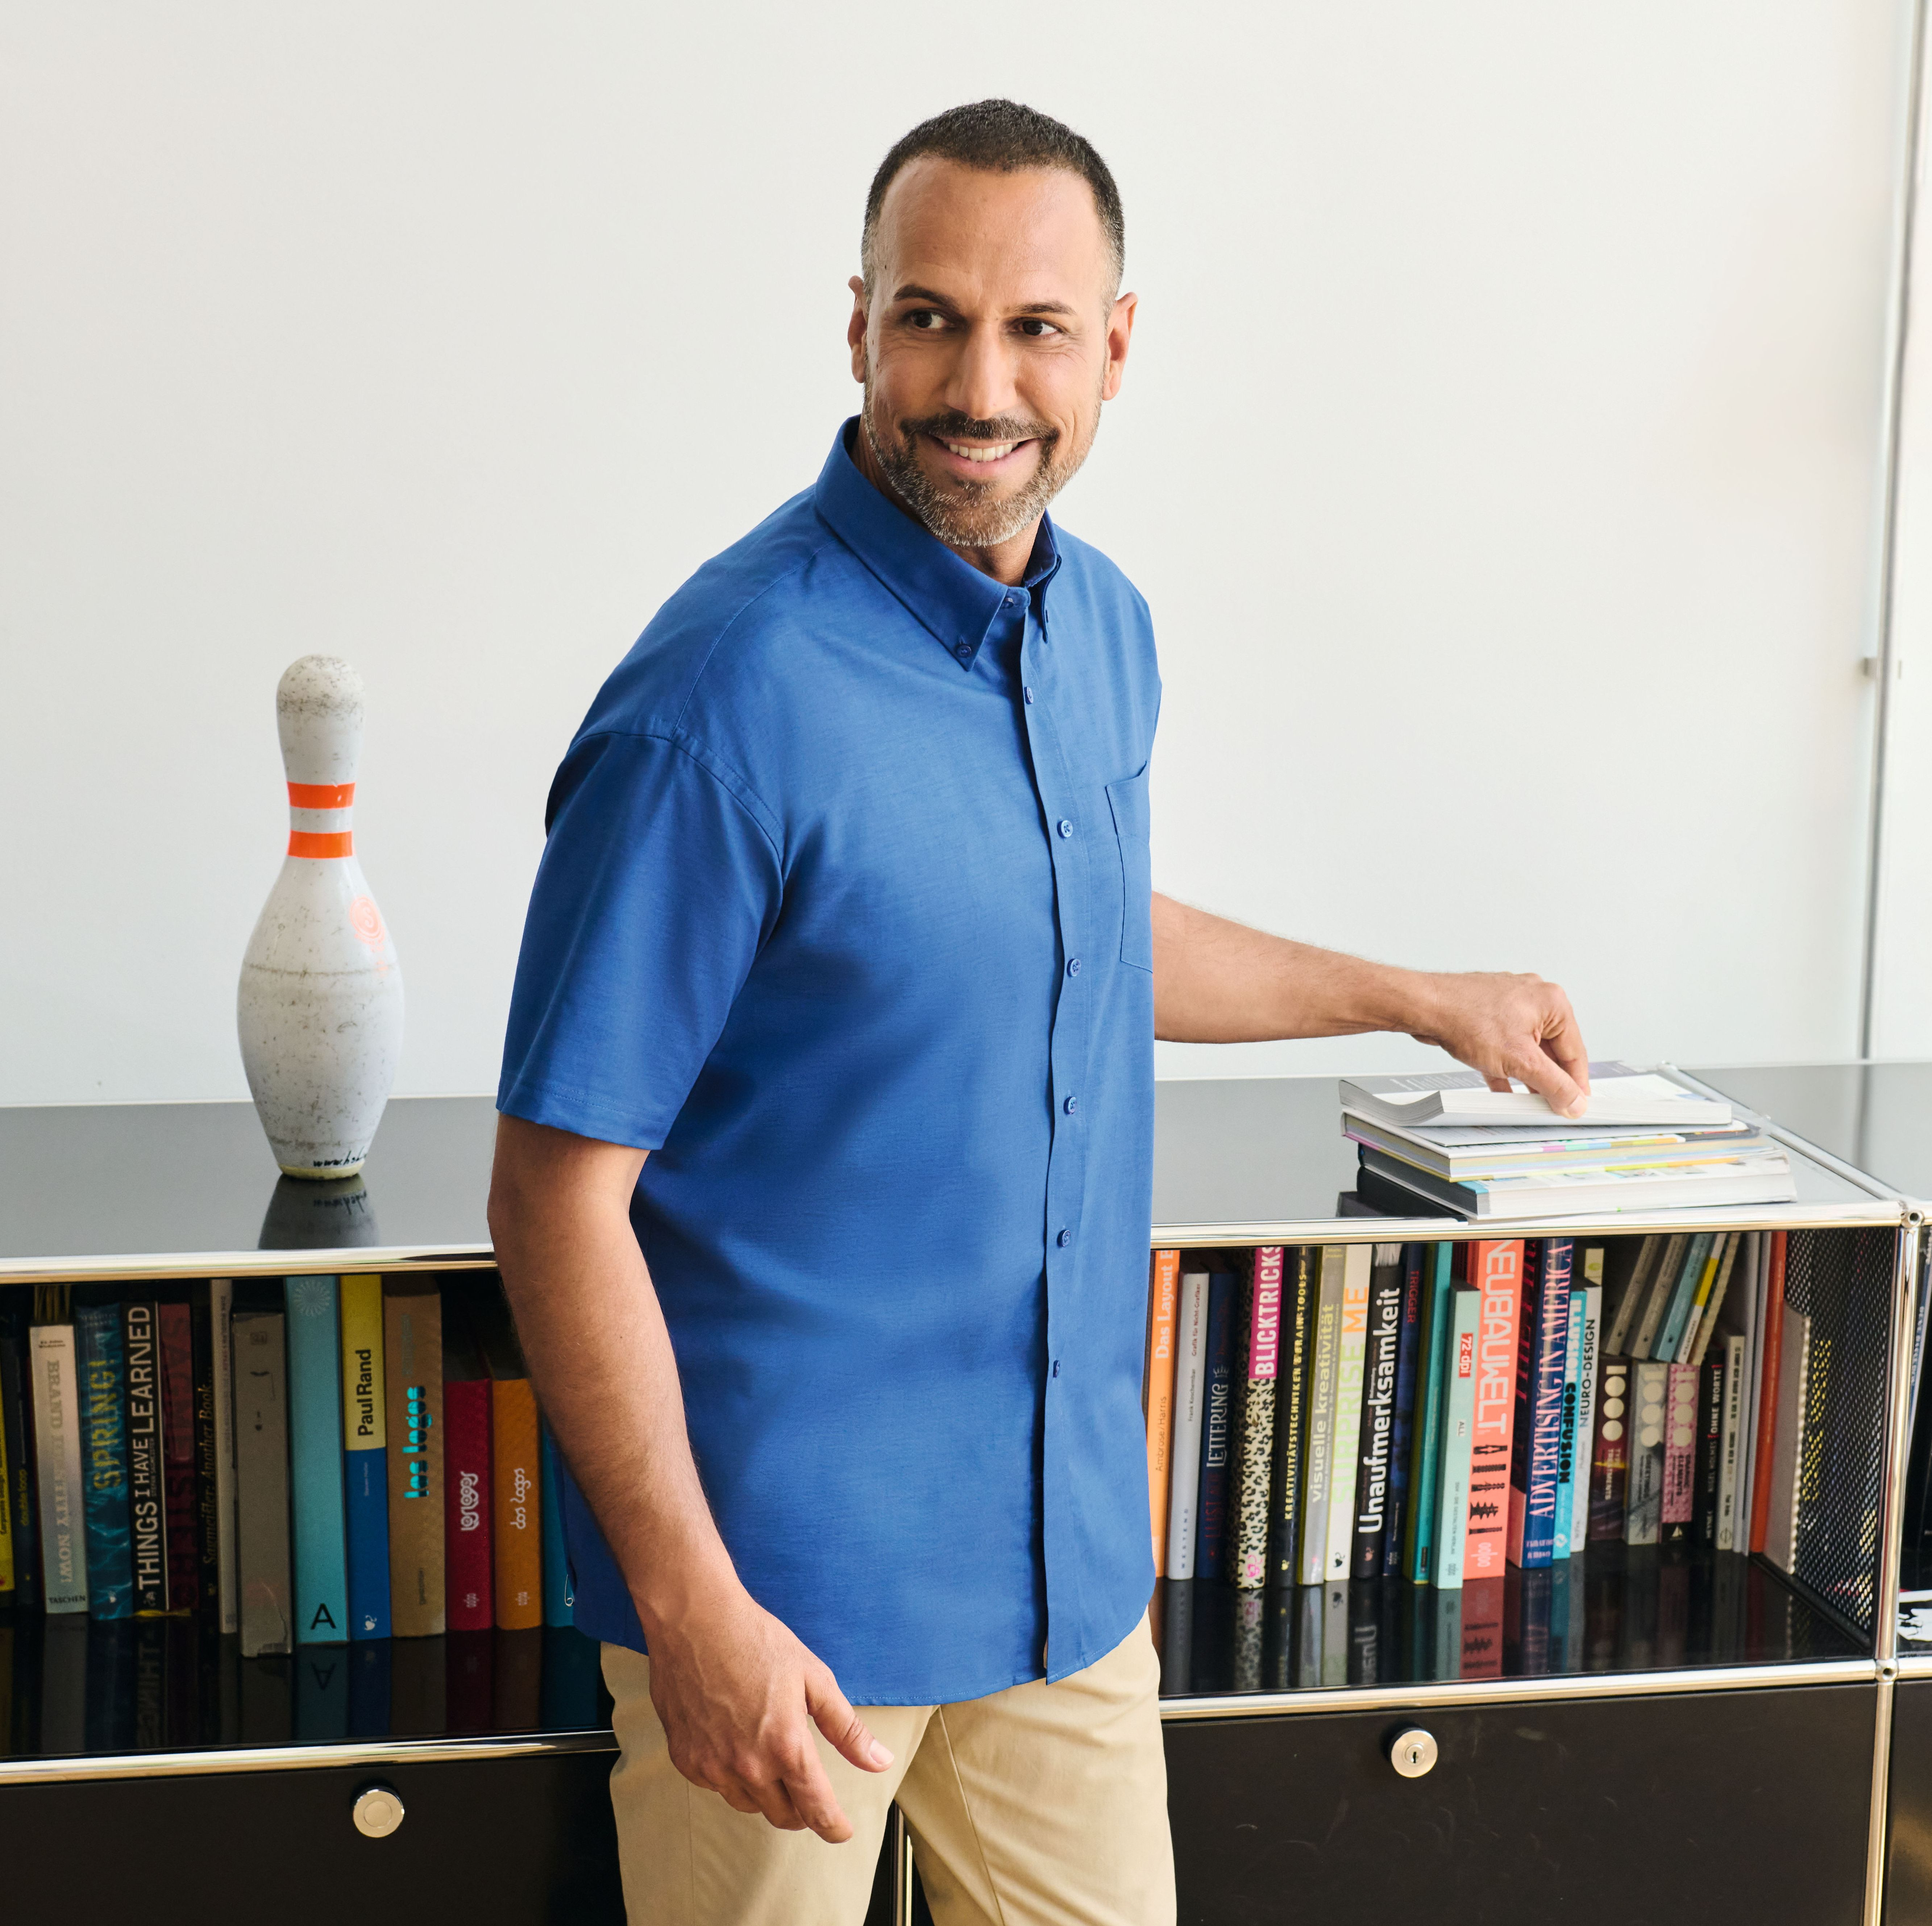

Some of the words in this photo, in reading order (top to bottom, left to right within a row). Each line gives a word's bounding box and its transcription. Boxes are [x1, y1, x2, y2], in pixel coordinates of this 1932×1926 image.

[1157, 1264, 1174, 1321] Layout
[1343, 1287, 1368, 1333] ME
[1407, 1270, 1420, 1323] TRIGGER
[1541, 1243, 1572, 1344] AMERICA
[128, 1306, 154, 1434] LEARNED
[355, 1349, 372, 1395] Rand
[1155, 1327, 1170, 1359] Das
[1314, 1304, 1333, 1414] kreativität
[1477, 1241, 1515, 1435] NEUBAUWELT
[1538, 1351, 1565, 1375] IN
[1565, 1299, 1583, 1382] ILLUSION
[1578, 1319, 1596, 1428] NEURO-DESIGN
[89, 1360, 121, 1490] SPRING!
[200, 1424, 214, 1479] Another
[357, 1399, 374, 1436] Paul
[403, 1385, 433, 1453] logos
[1155, 1396, 1167, 1472] Ambrose/Harris
[1206, 1384, 1229, 1468] LETTERING
[1284, 1368, 1302, 1520] KREATIVITÄTSTECHNIKEN
[1331, 1343, 1364, 1503] SURPRISE
[1358, 1288, 1400, 1534] Unaufmerksamkeit
[1529, 1378, 1563, 1519] ADVERTISING
[1559, 1382, 1576, 1484] CONFUSION
[47, 1360, 63, 1429] BRAND
[58, 1534, 73, 1583] NOW!
[132, 1437, 149, 1485] HAVE
[134, 1489, 150, 1498] I
[404, 1460, 429, 1498] los
[1310, 1420, 1326, 1503] visuelle
[135, 1501, 161, 1590] THINGS
[510, 1507, 526, 1530] dos
[311, 1603, 336, 1630] A
